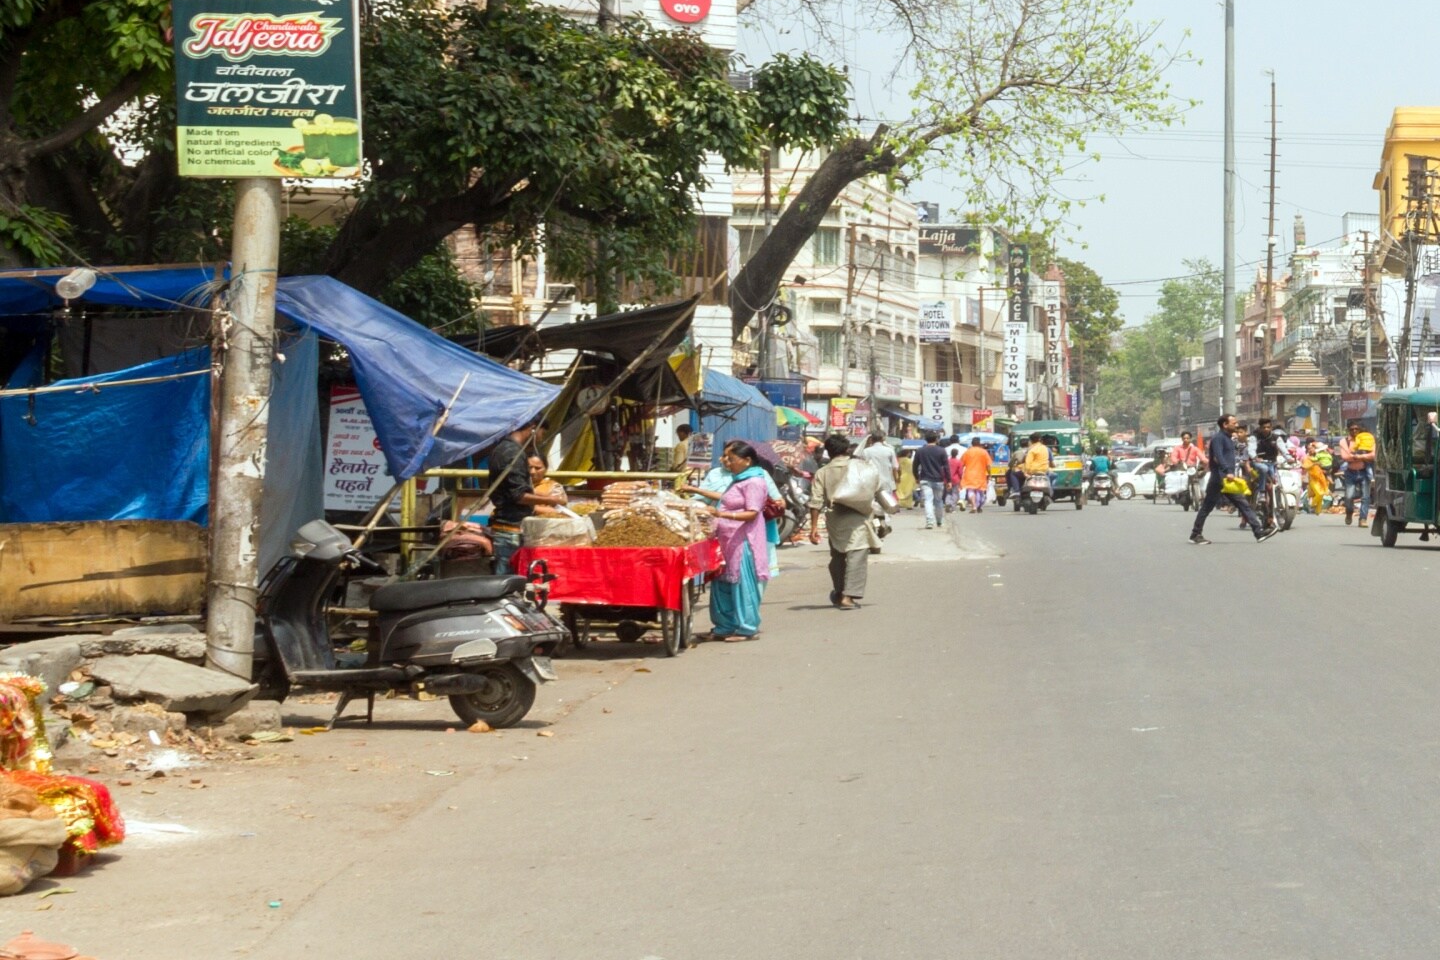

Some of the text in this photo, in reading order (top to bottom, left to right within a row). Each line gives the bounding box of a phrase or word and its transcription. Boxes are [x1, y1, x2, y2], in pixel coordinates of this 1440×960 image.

[673, 3, 700, 14] OYO
[191, 19, 323, 55] Jaljeera
[185, 77, 346, 105] जलजीरा
[207, 105, 269, 117] जलजीरा
[225, 139, 281, 147] ingredients
[204, 148, 245, 156] artificial
[204, 158, 256, 166] chemicals
[1013, 268, 1022, 321] PALACE
[923, 310, 945, 319] HOTEL
[920, 320, 950, 329] MIDTOWN
[1008, 329, 1020, 388] MIDTOWN
[931, 388, 943, 421] MIDTO
[330, 458, 380, 475] हैलमेट
[335, 476, 374, 493] पहनें
